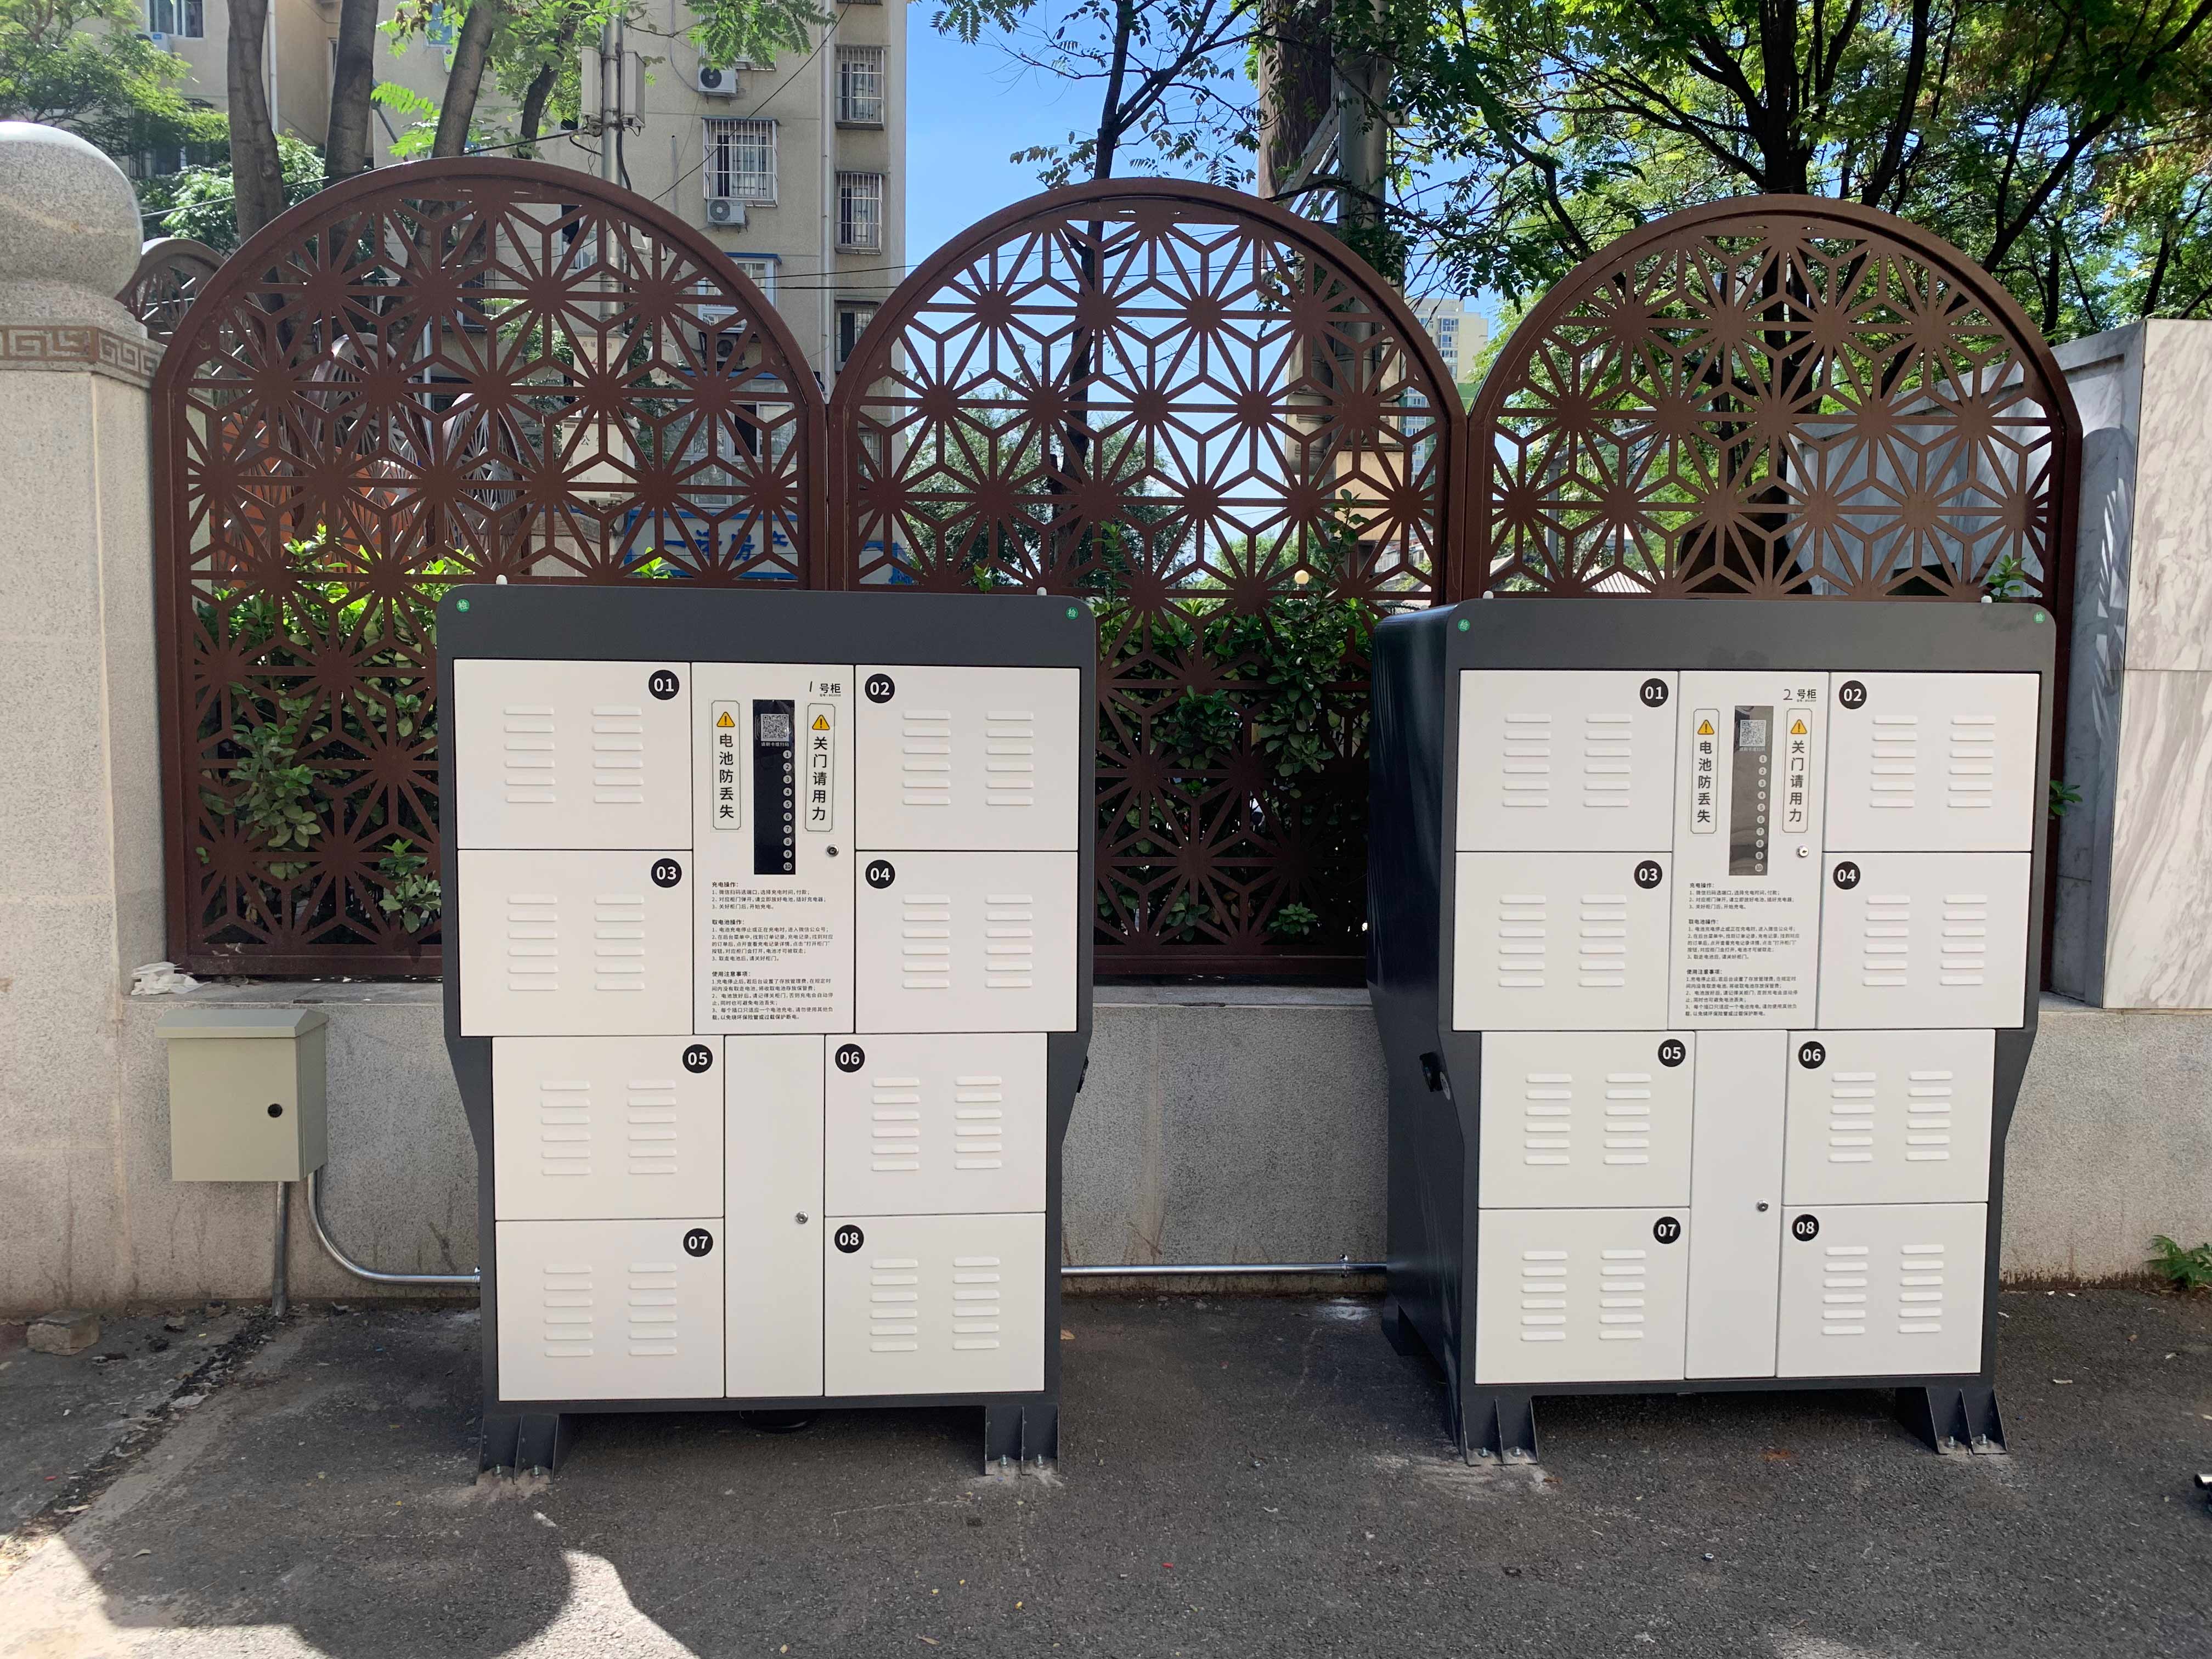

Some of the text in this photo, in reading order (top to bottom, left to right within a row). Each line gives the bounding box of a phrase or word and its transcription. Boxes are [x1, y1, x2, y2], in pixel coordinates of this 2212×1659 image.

[458, 600, 468, 610] 检
[1068, 608, 1076, 617] 检
[654, 678, 674, 692] 01
[819, 683, 841, 693] 号柜
[870, 682, 889, 695] 02
[1645, 686, 1663, 699] 01
[1783, 689, 1816, 700] 2 号柜
[1844, 689, 1861, 701] 02
[719, 733, 734, 819] 电池防丢失
[812, 736, 828, 821] 关门请用力
[1697, 741, 1712, 823] 电池防丢失
[1789, 741, 1805, 822] 关门请用力
[657, 867, 676, 880] 03
[871, 868, 890, 881] 04
[1639, 868, 1657, 881] 03
[1838, 870, 1855, 882] 04
[688, 1052, 707, 1065] 05
[840, 1052, 859, 1064] 06
[1663, 1047, 1680, 1059] 05
[1803, 1049, 1821, 1061] 06
[1658, 1224, 1676, 1237] 07
[1797, 1222, 1814, 1234] 08
[689, 1237, 708, 1249] 07
[840, 1233, 859, 1245] 08
